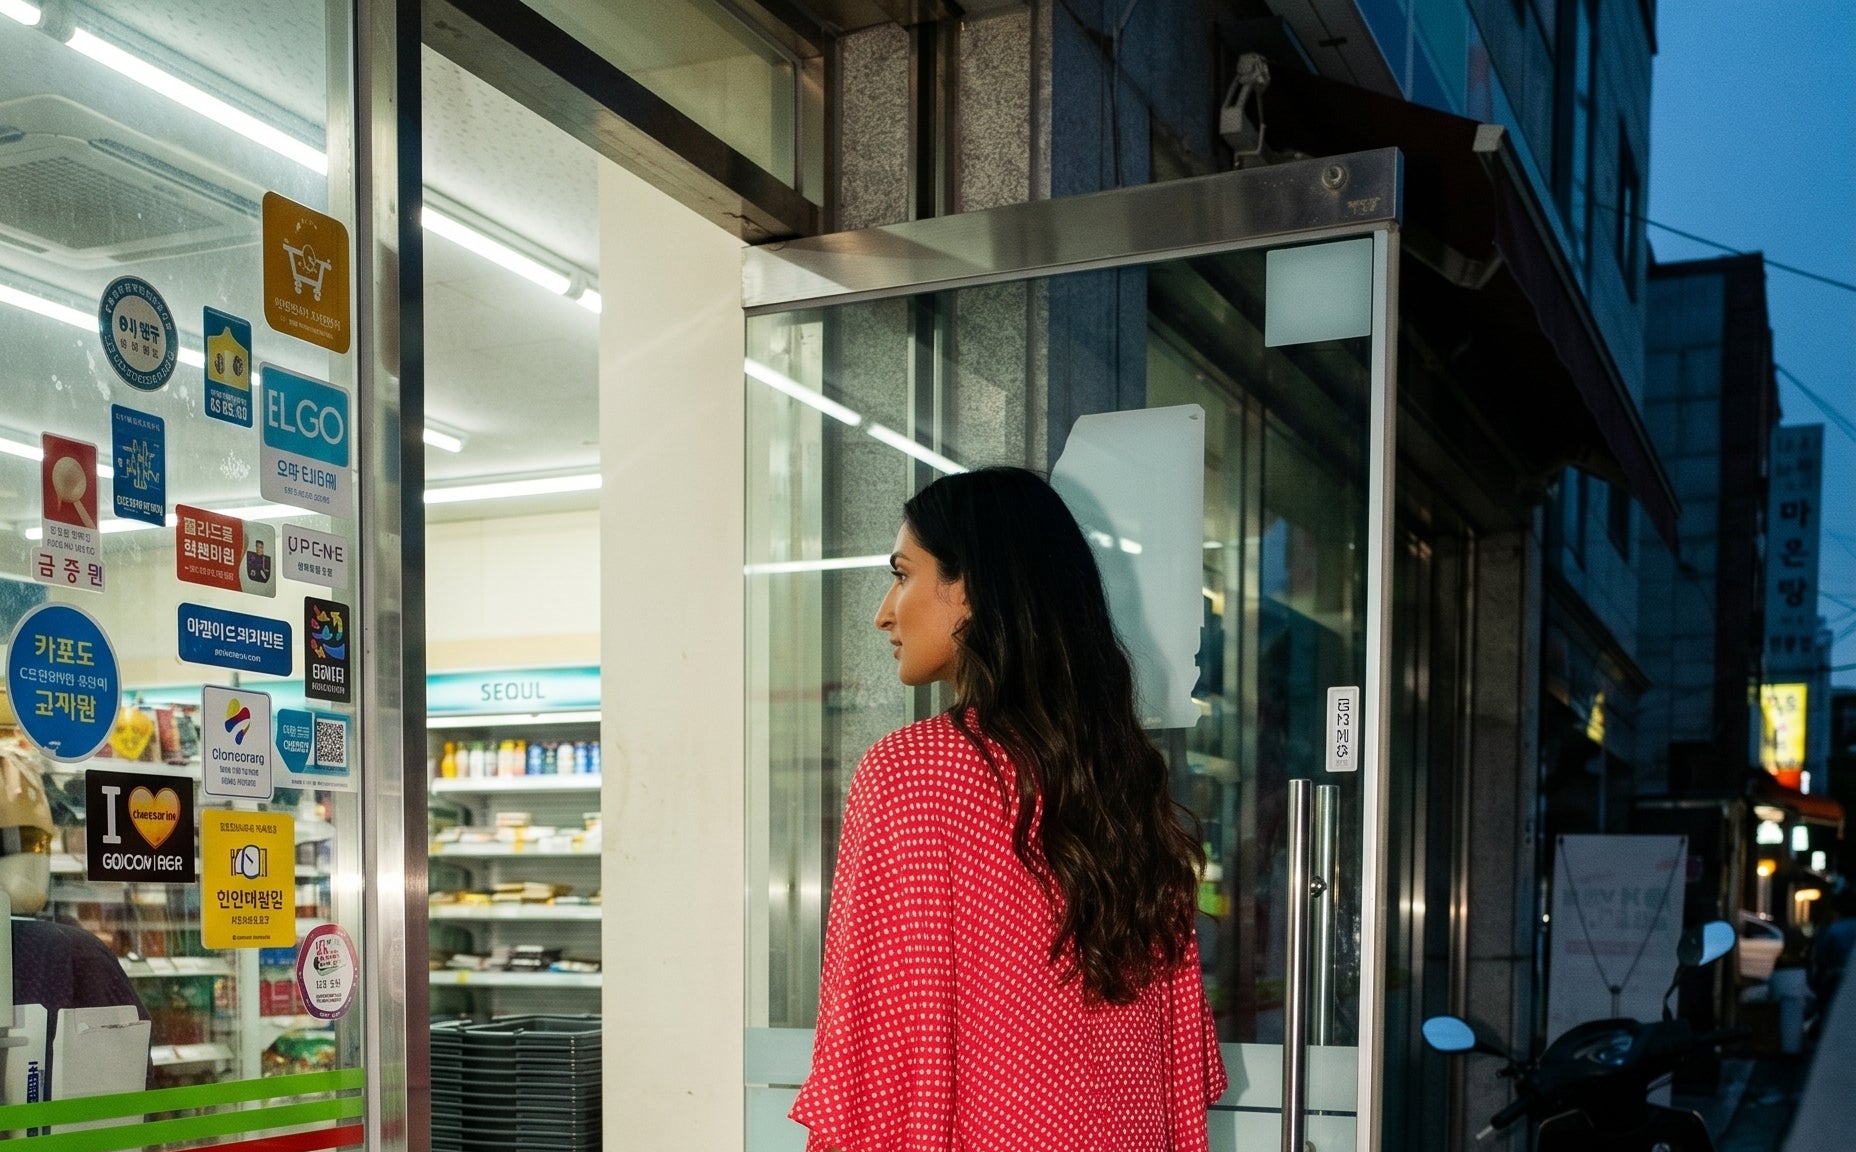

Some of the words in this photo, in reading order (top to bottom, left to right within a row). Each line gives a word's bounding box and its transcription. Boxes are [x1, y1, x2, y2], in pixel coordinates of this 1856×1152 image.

[268, 389, 344, 445] ELGO
[480, 681, 546, 702] SEOUL
[101, 785, 122, 844] I
